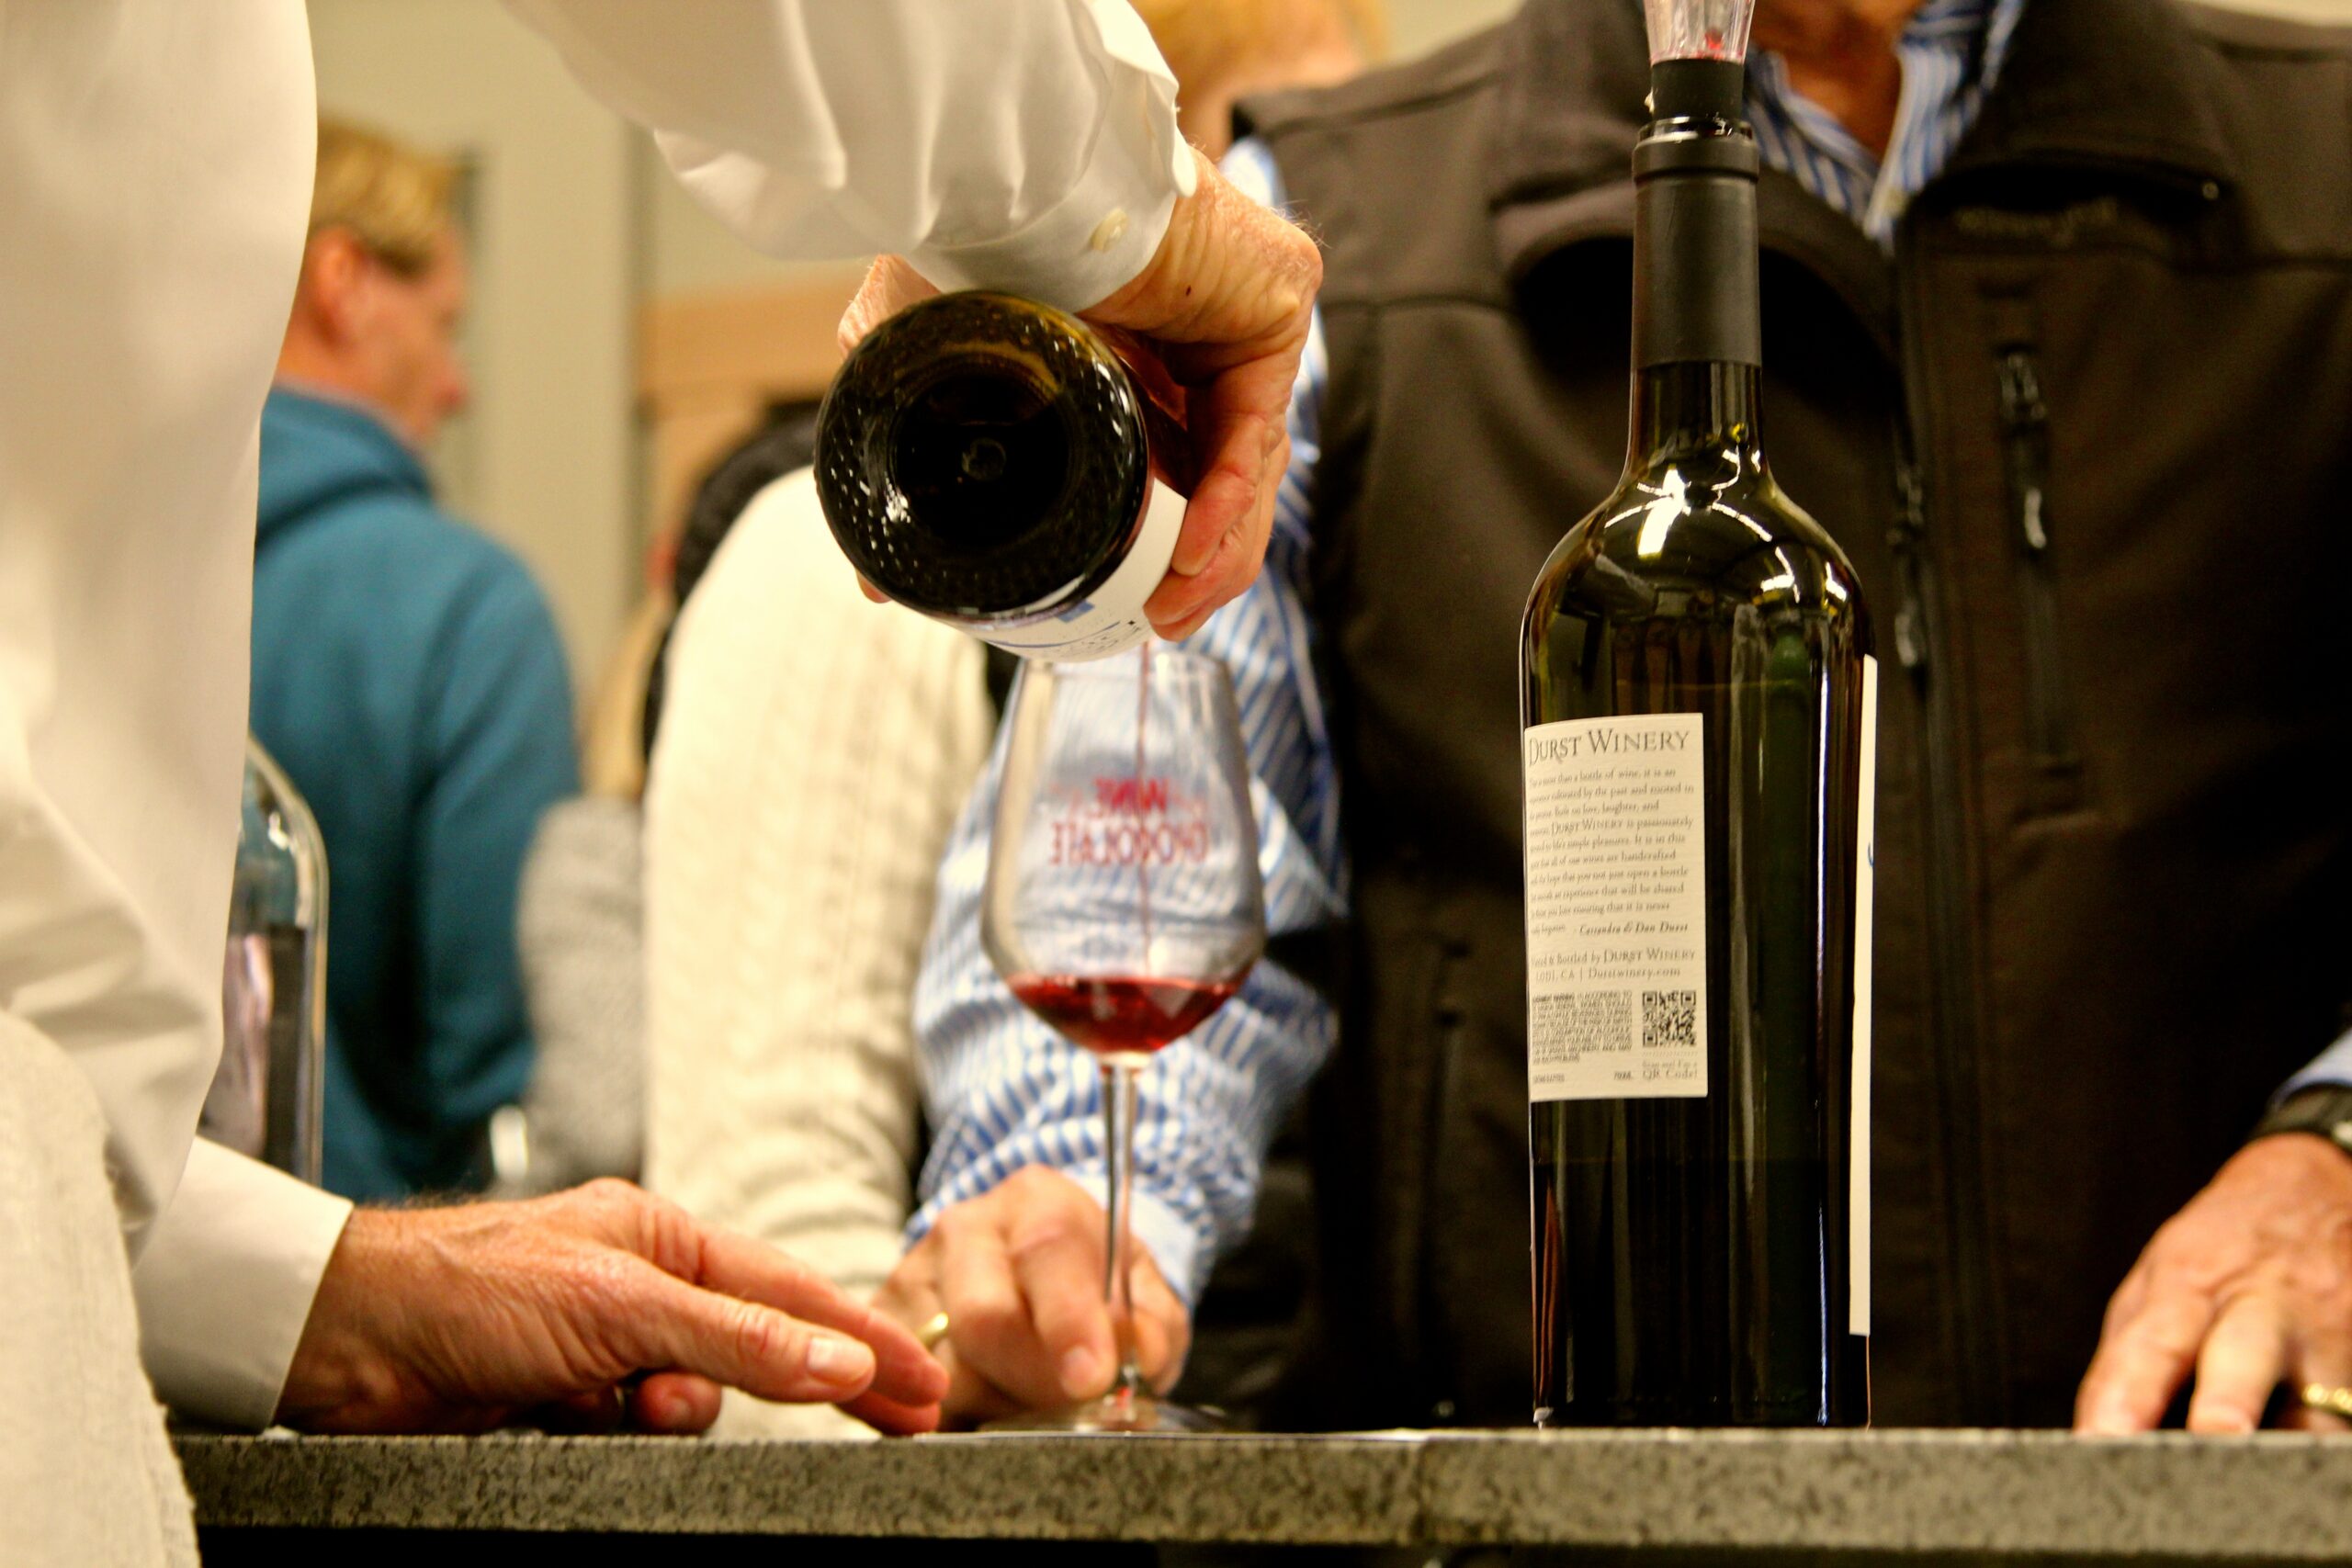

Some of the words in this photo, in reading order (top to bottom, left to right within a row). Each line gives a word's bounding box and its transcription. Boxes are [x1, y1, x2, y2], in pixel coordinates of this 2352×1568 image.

[1529, 737, 1581, 766] DURST
[1588, 728, 1690, 755] WINERY
[1580, 770, 1601, 780] bottle
[1605, 767, 1615, 779] of
[1644, 768, 1651, 778] it
[1654, 769, 1660, 777] is
[1665, 768, 1676, 777] an
[1583, 786, 1593, 800] by
[1595, 786, 1607, 796] the
[1610, 785, 1627, 800] past
[1632, 783, 1647, 795] and
[1650, 782, 1681, 795] rooted
[1685, 784, 1694, 795] in
[1643, 799, 1659, 811] and
[1551, 822, 1578, 836] DURST
[1581, 818, 1623, 831] WINERY
[1626, 819, 1634, 829] is
[1636, 816, 1693, 831] passionately
[1645, 835, 1652, 844] is
[1656, 834, 1665, 843] in
[1668, 832, 1686, 843] this
[1621, 848, 1676, 862] handcrafted
[1626, 869, 1650, 882] open
[1660, 864, 1689, 876] bottle
[1601, 885, 1618, 897] that
[1621, 883, 1637, 895] will
[1640, 882, 1650, 894] be
[1653, 881, 1685, 894] shared
[1606, 899, 1623, 911] that
[1625, 902, 1633, 911] it
[1635, 902, 1644, 911] is
[1635, 921, 1656, 933] Dan
[1660, 920, 1689, 933] Durst
[1591, 949, 1602, 964] by
[1604, 947, 1644, 963] DURST
[1646, 946, 1696, 962] WINERY
[1589, 965, 1681, 980] Durstwinery.com
